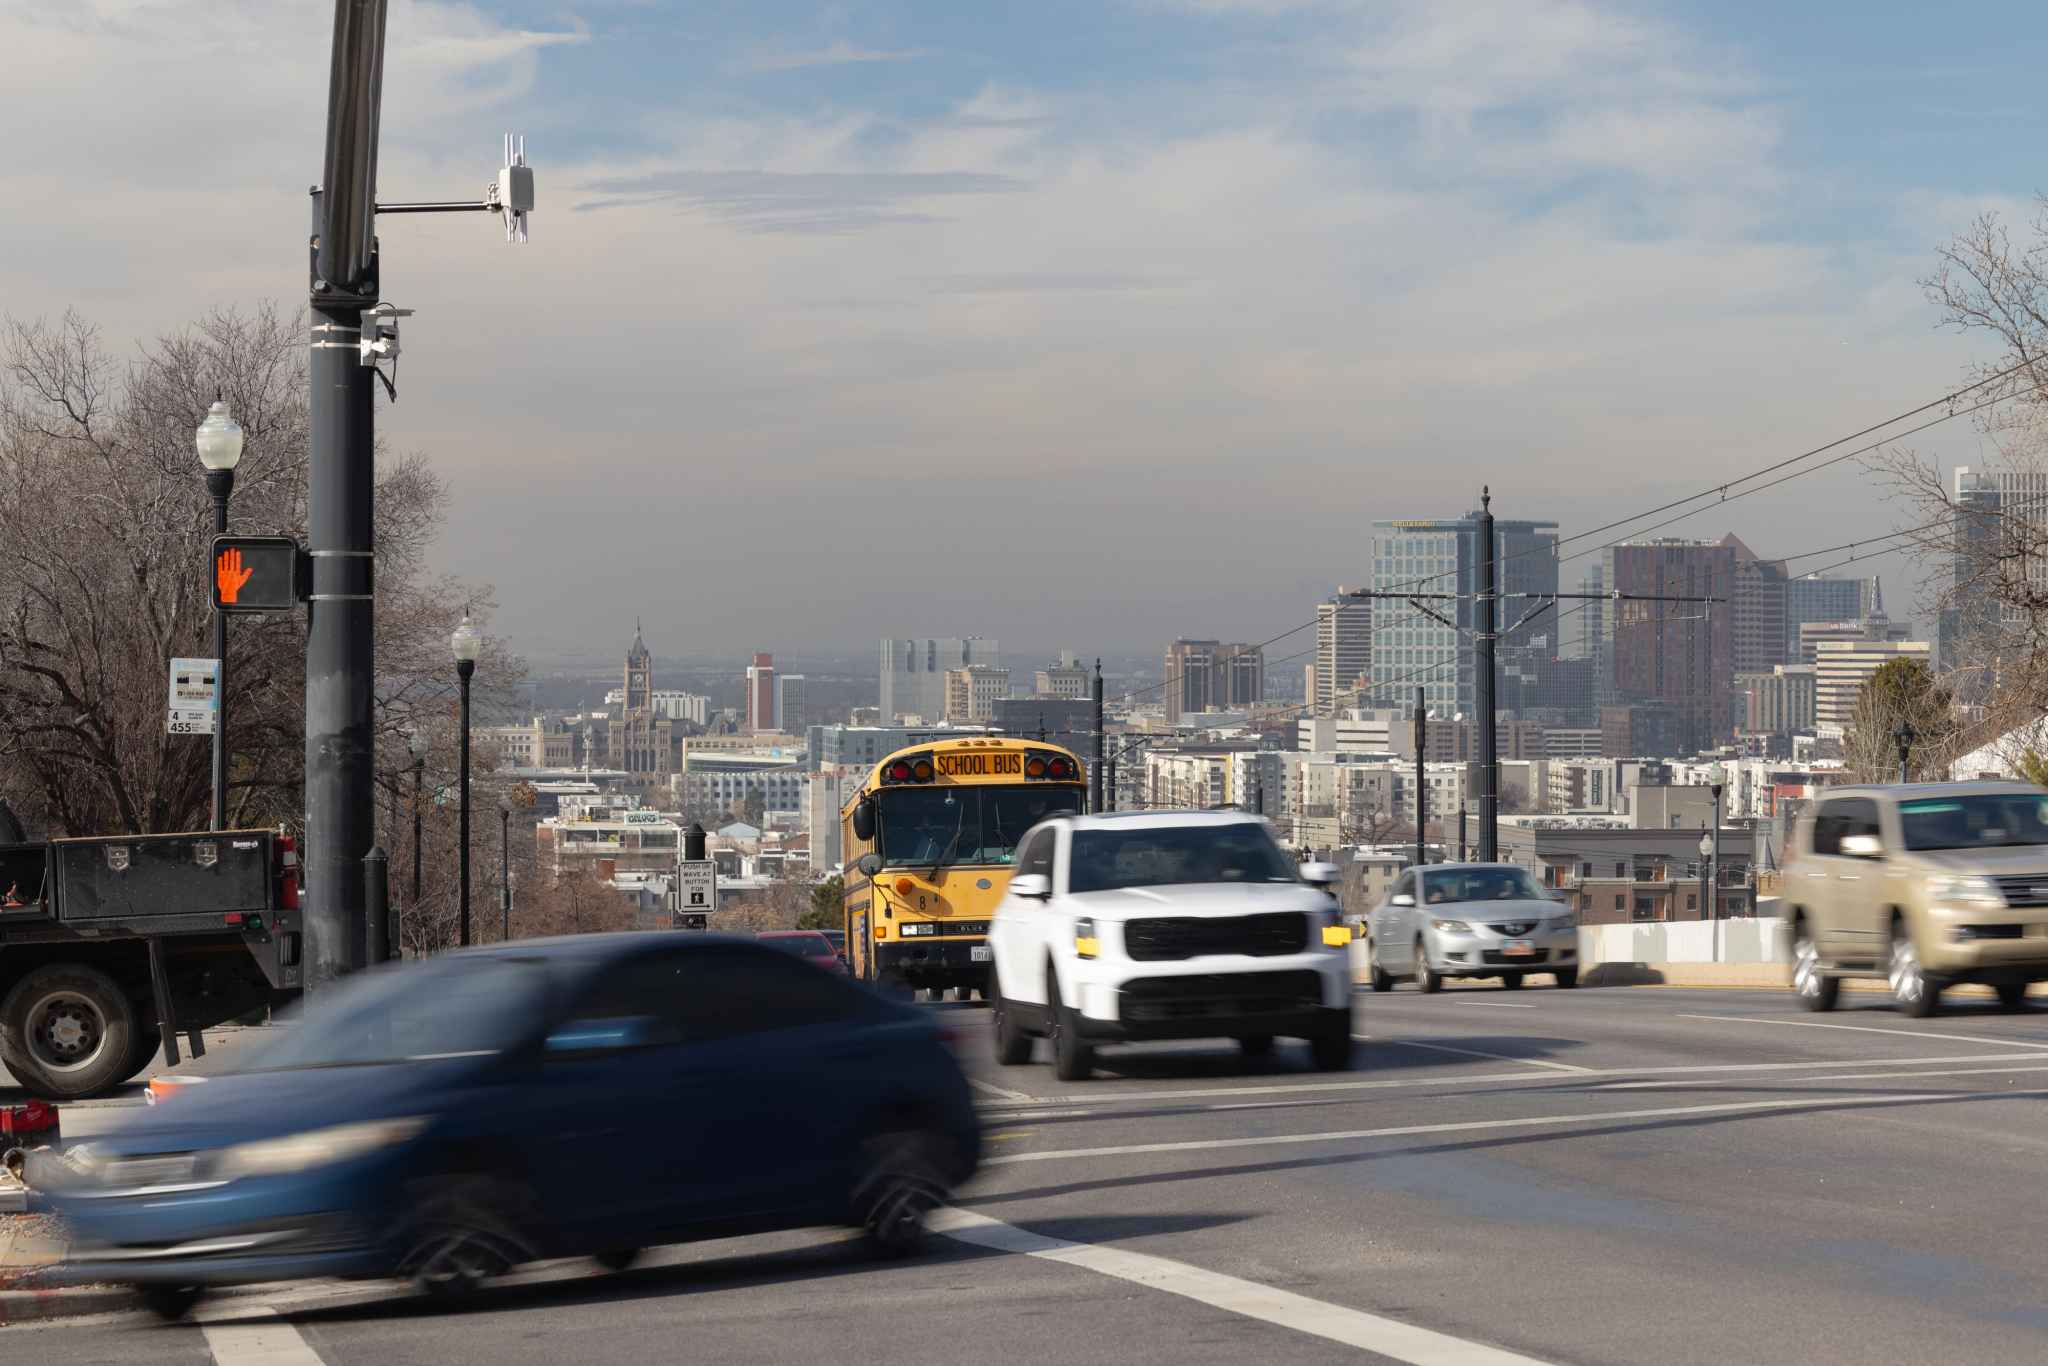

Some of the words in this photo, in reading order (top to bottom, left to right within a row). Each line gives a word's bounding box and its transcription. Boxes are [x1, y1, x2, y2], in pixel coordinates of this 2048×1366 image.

[172, 711, 179, 721] 4
[170, 722, 192, 733] 455
[937, 755, 991, 776] SCHOOL
[994, 753, 1021, 774] BUS
[919, 895, 926, 910] 8
